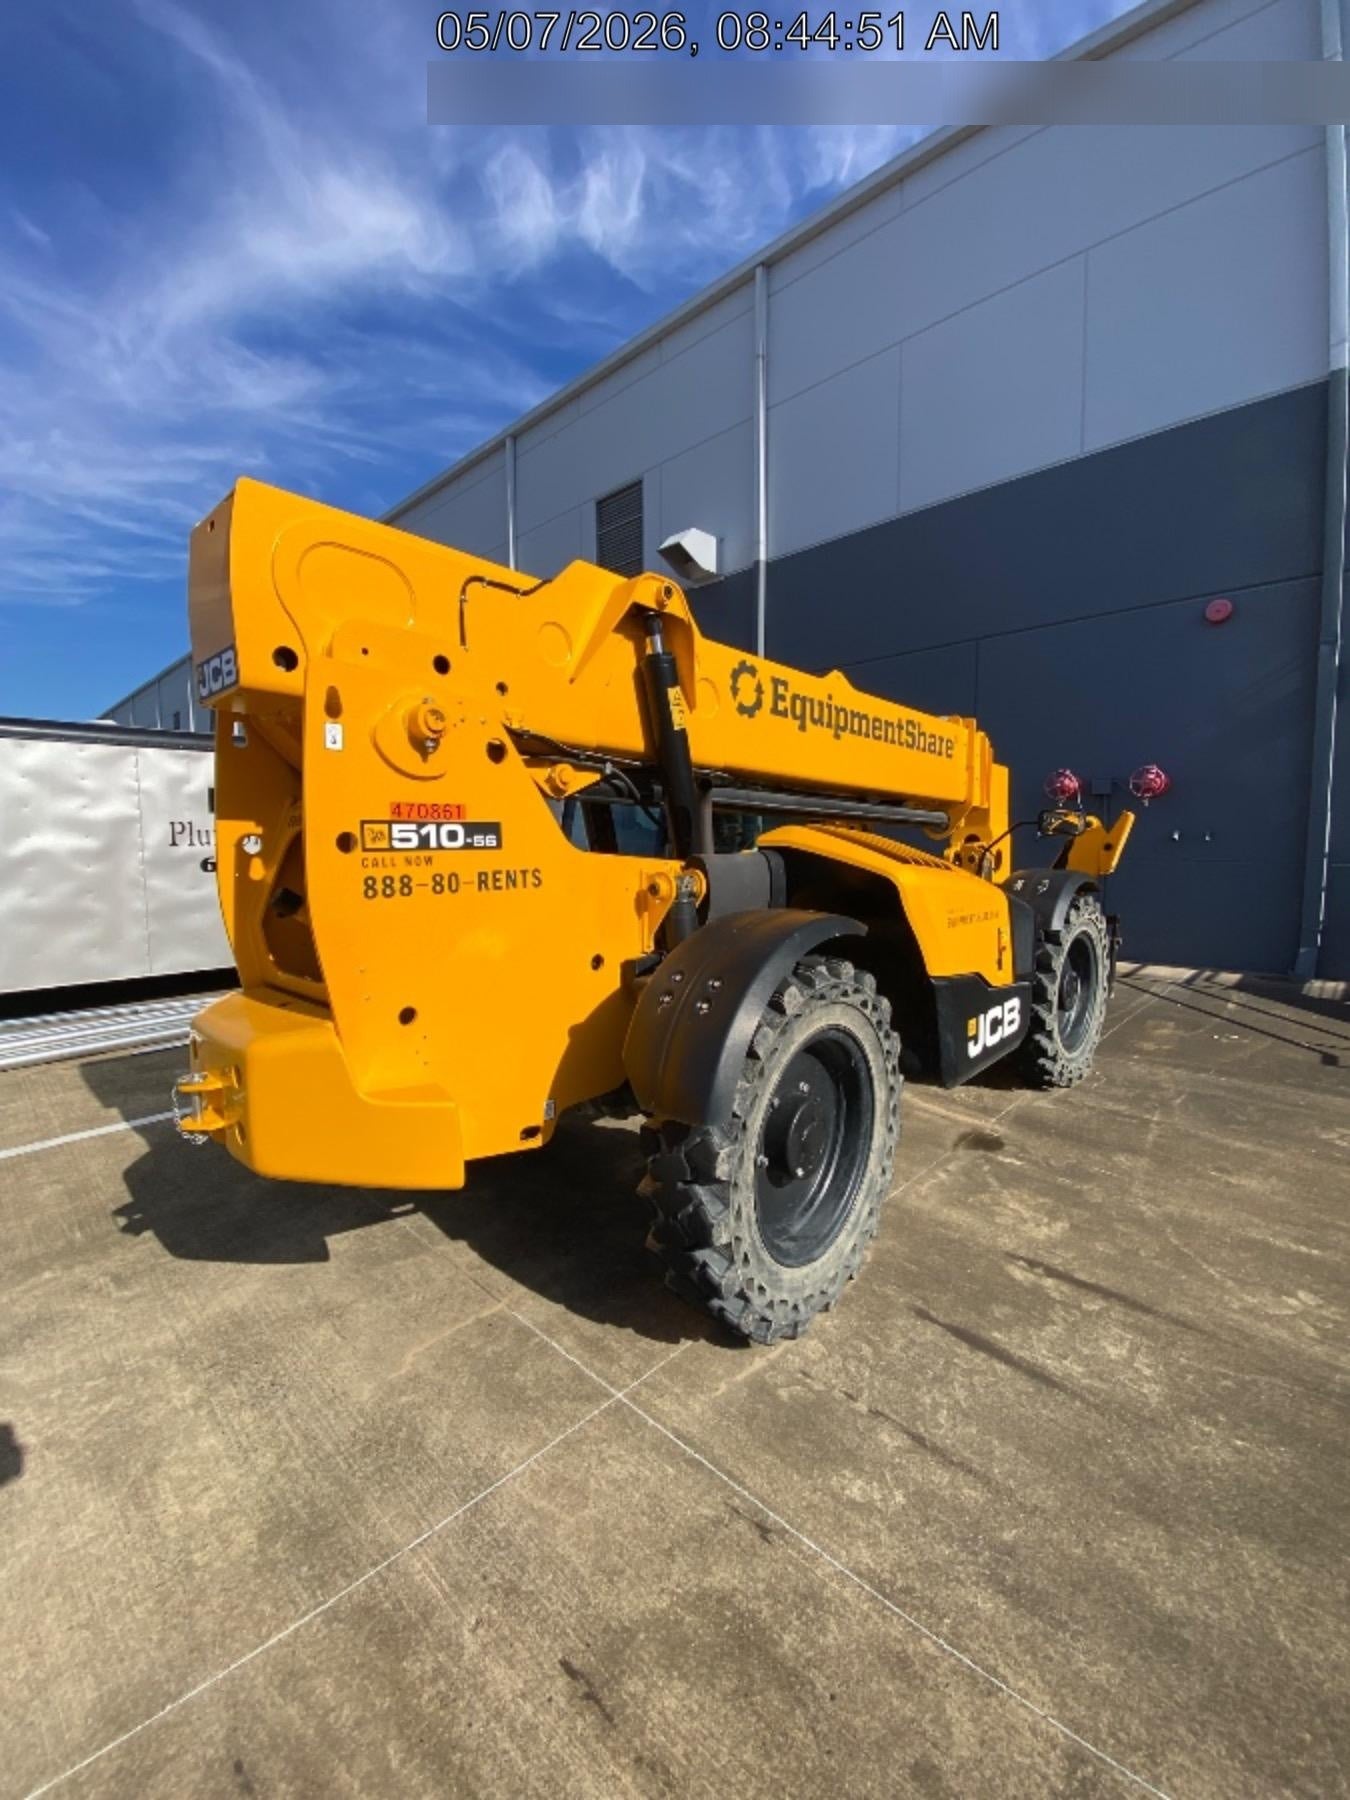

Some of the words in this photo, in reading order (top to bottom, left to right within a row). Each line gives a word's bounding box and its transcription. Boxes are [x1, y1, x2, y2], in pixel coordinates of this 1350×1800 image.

[199, 649, 236, 697] JCB
[770, 675, 955, 760] EquipmentShare
[391, 802, 463, 820] 470861
[168, 821, 216, 847] Plu
[361, 857, 397, 869] CALL
[405, 856, 433, 867] NOW
[363, 868, 543, 900] 888-80-RENTS
[967, 996, 1021, 1059] JCB
